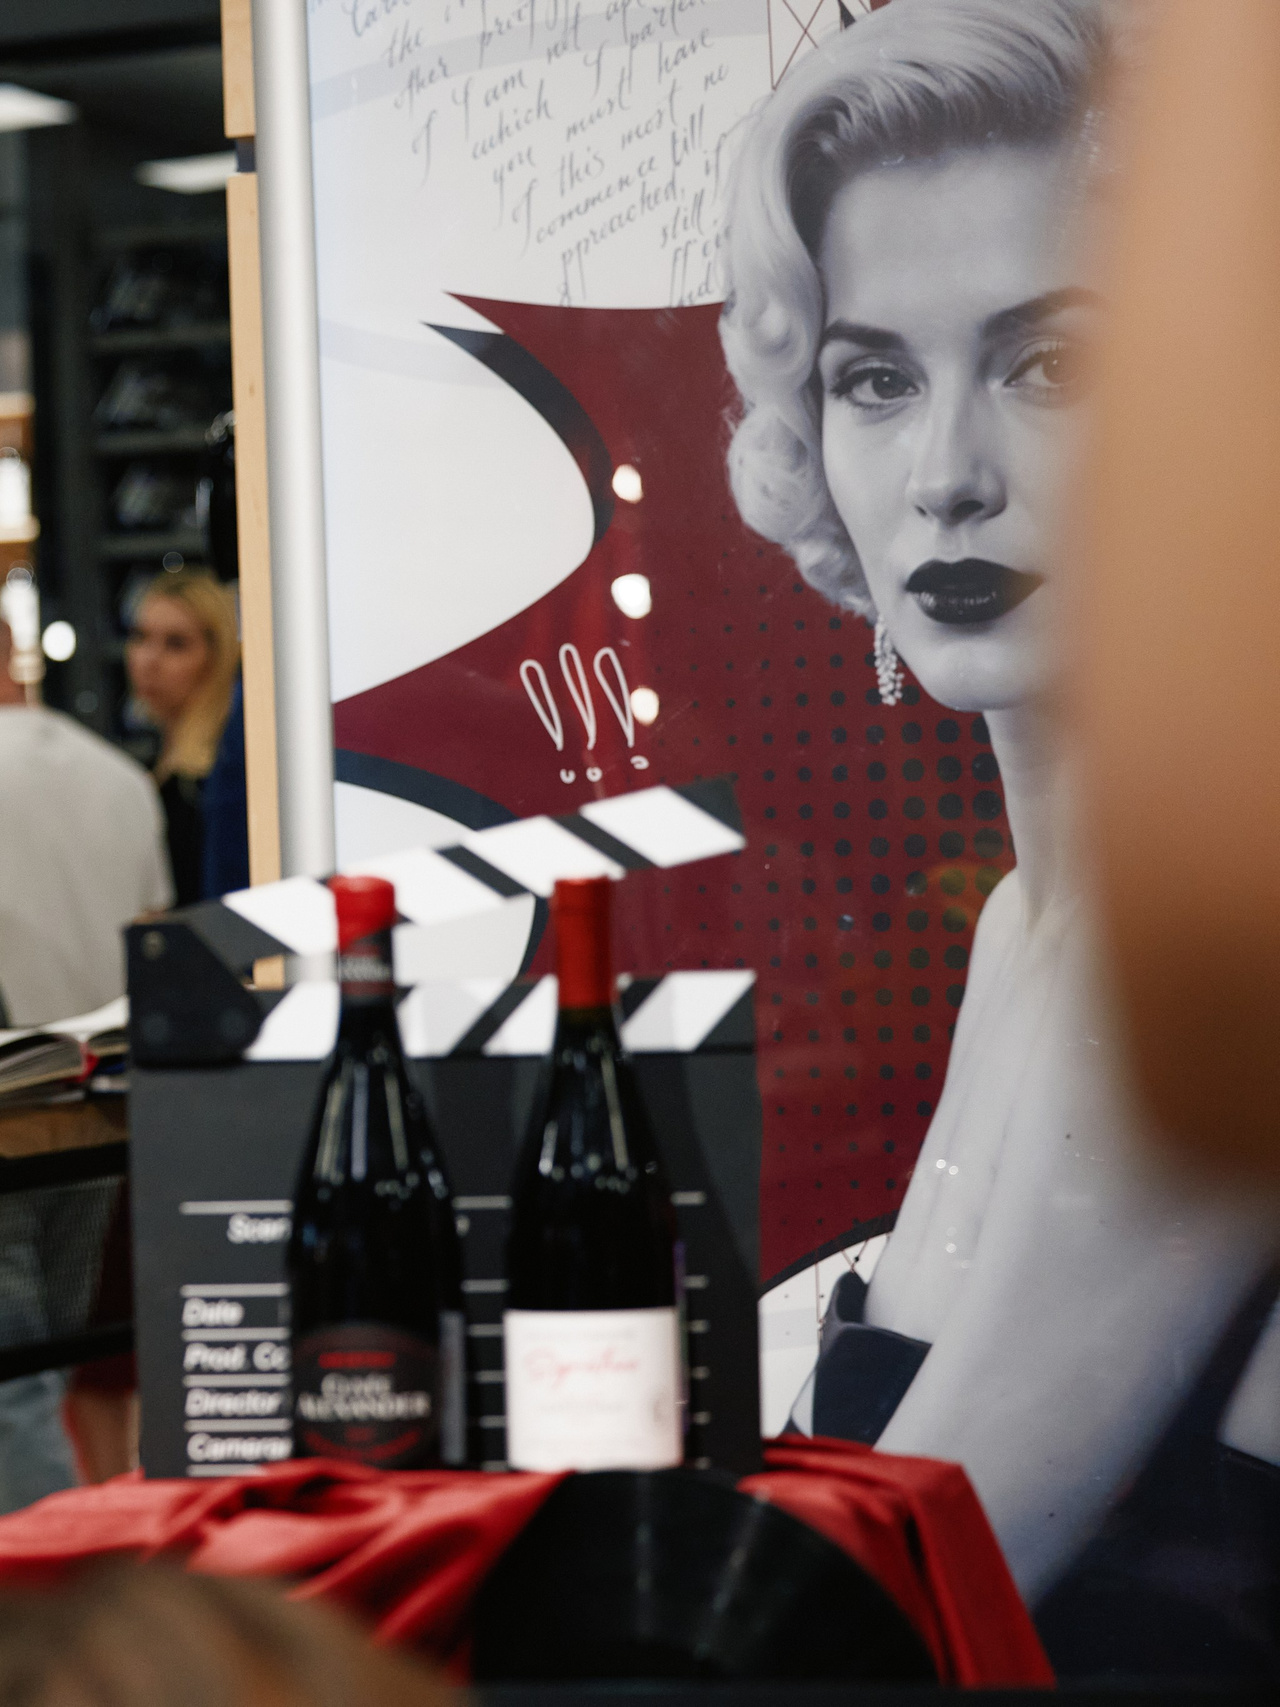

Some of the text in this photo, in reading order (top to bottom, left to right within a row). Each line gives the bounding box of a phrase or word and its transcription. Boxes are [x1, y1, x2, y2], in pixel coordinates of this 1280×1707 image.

[382, 20, 423, 68] the
[484, 69, 529, 107] am
[472, 79, 554, 160] which
[492, 28, 713, 231] you must have
[557, 147, 605, 198] this
[621, 78, 679, 150] most
[536, 104, 704, 244] commence till
[227, 1212, 292, 1244] Scen
[182, 1297, 245, 1327] Date
[183, 1342, 250, 1371] Prod.
[184, 1388, 282, 1417] Director
